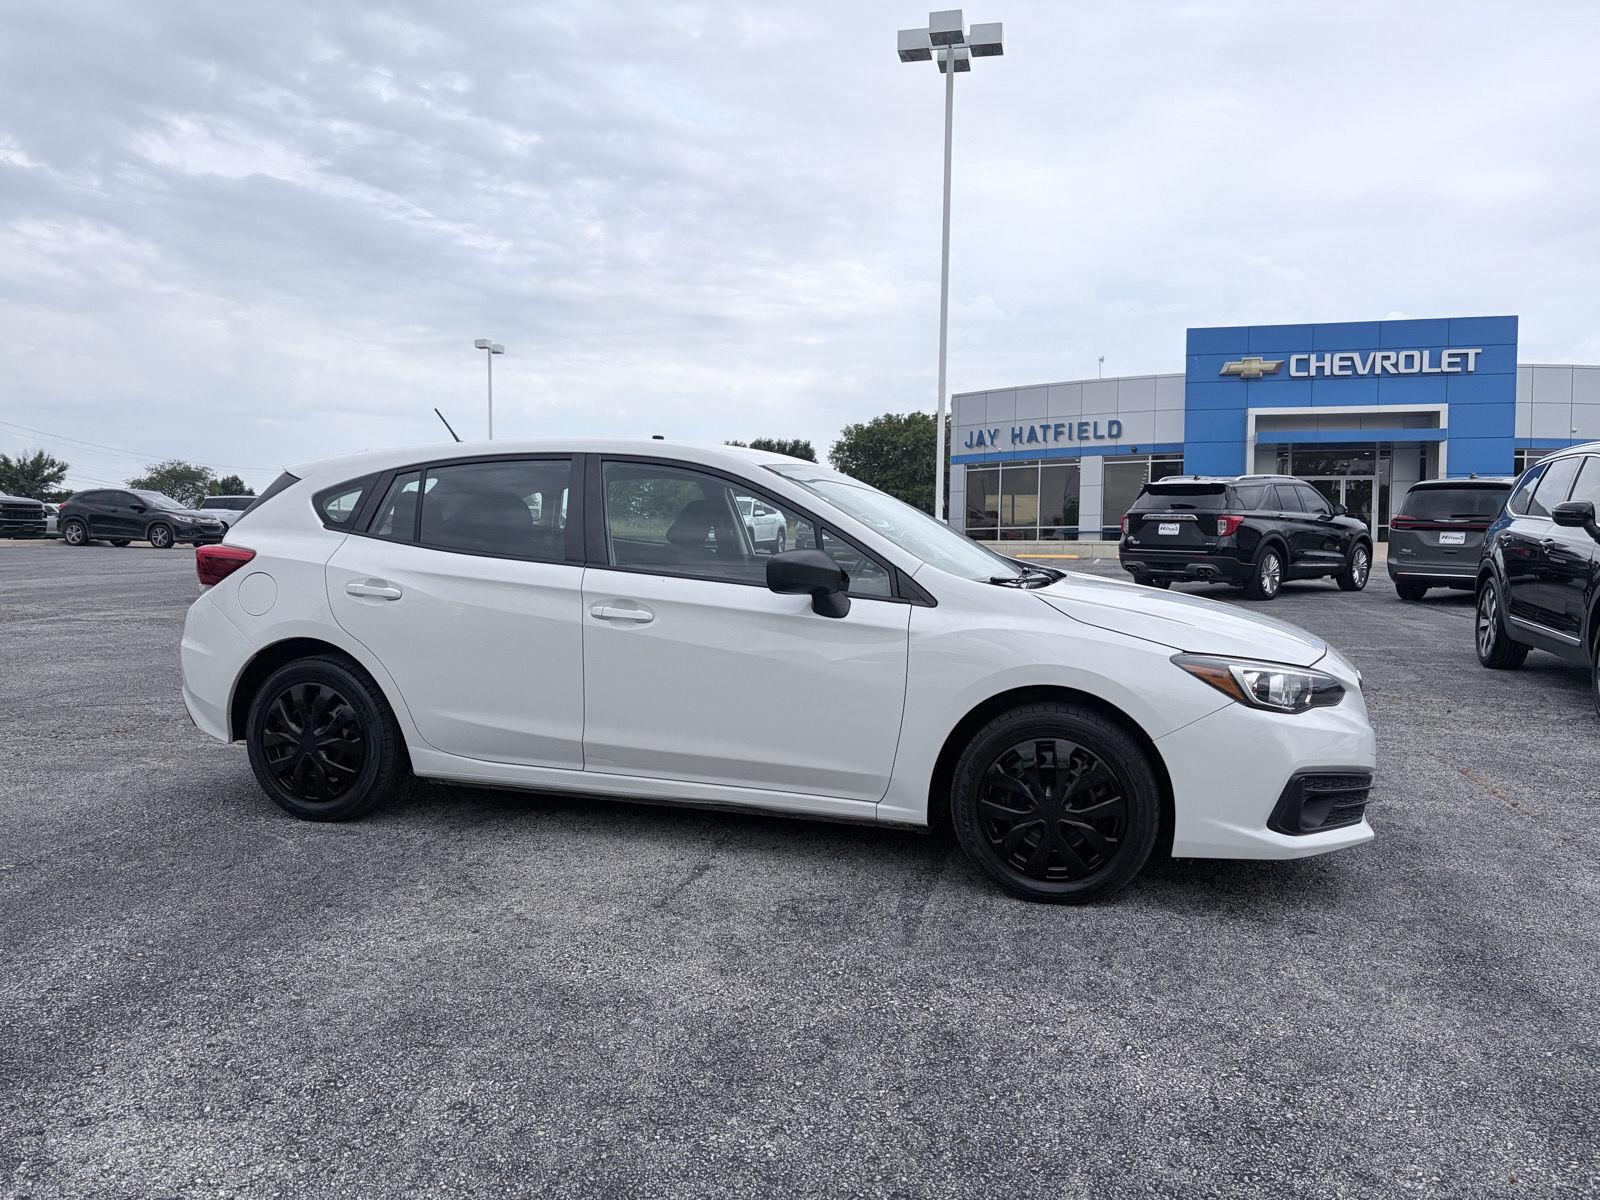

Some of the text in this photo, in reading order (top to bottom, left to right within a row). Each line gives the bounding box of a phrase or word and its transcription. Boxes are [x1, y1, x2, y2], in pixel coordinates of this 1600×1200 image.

[1289, 348, 1483, 377] CHEVROLET
[964, 419, 1123, 448] JAY HATFIELD
